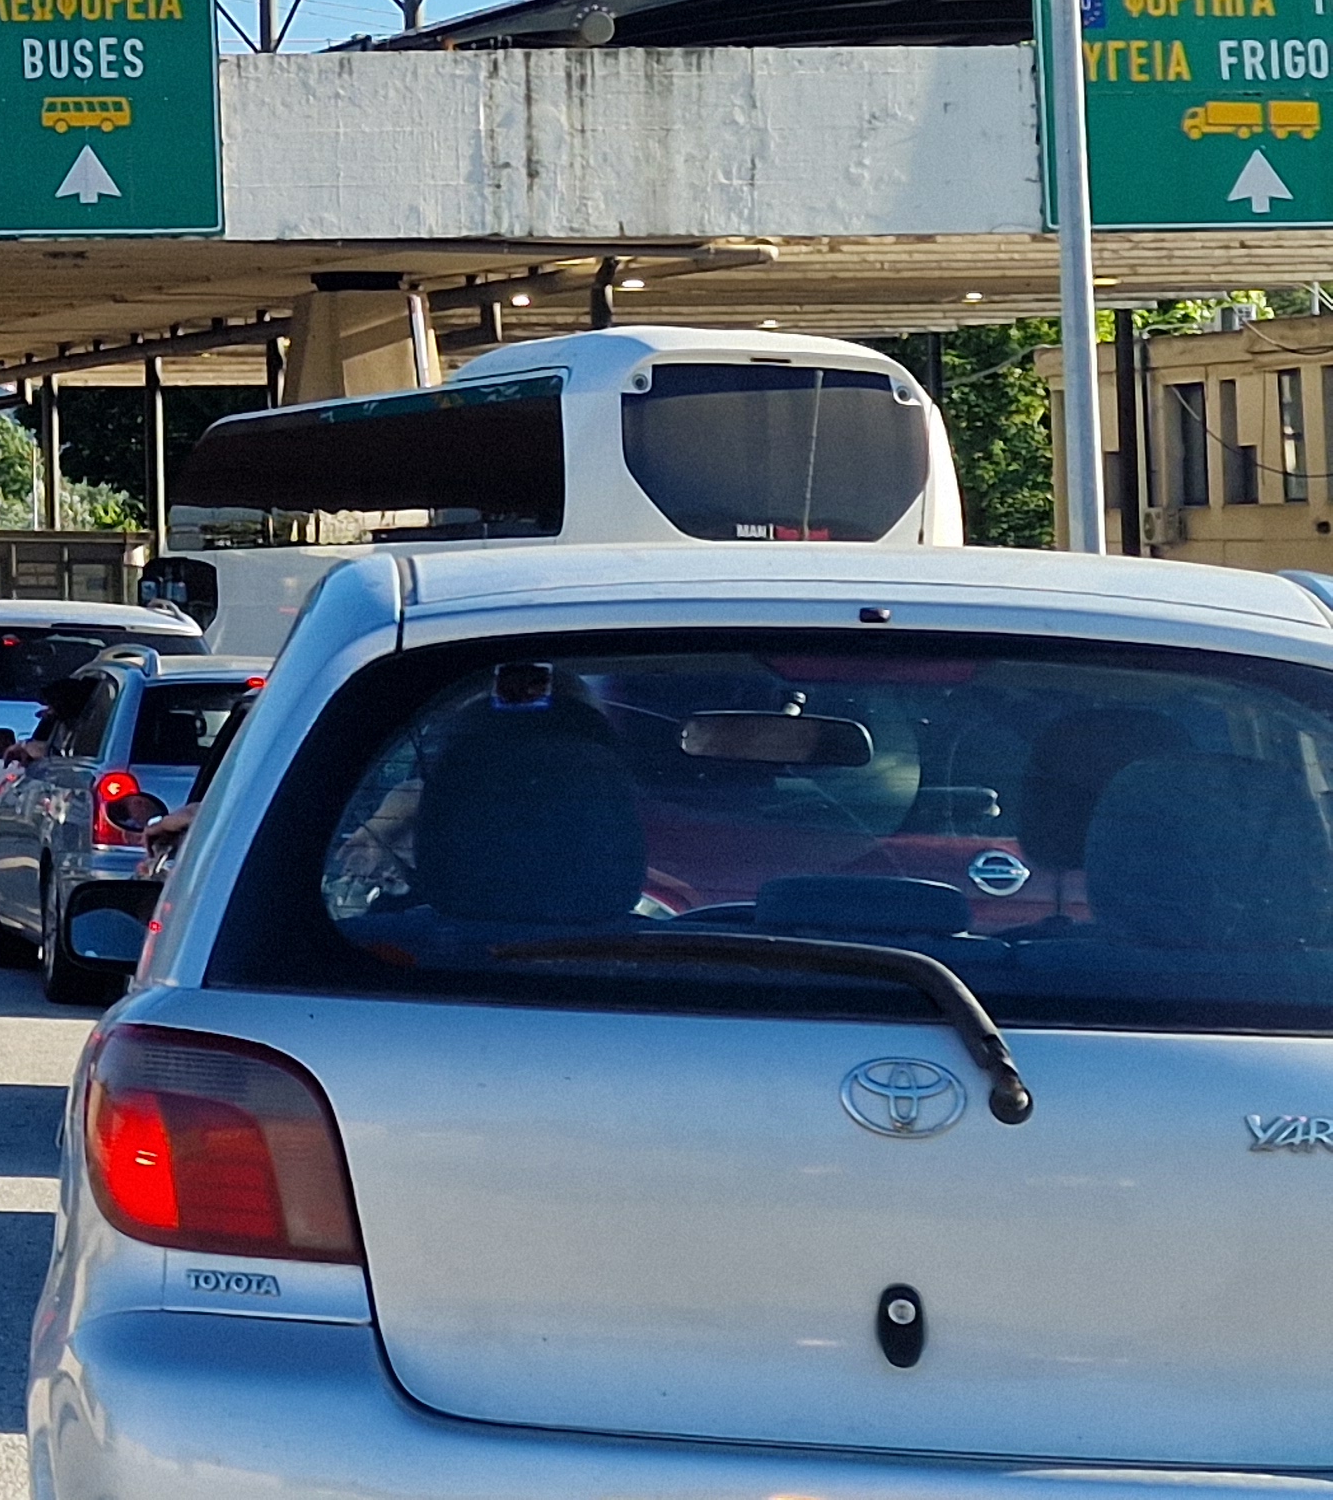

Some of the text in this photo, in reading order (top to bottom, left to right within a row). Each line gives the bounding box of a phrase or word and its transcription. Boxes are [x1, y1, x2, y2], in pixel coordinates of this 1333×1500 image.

[22, 37, 146, 81] BUSES
[1081, 38, 1329, 82] ΥΓΕΙΑ FRIGO
[736, 523, 767, 538] MAN
[186, 1268, 282, 1298] TOYOTA
